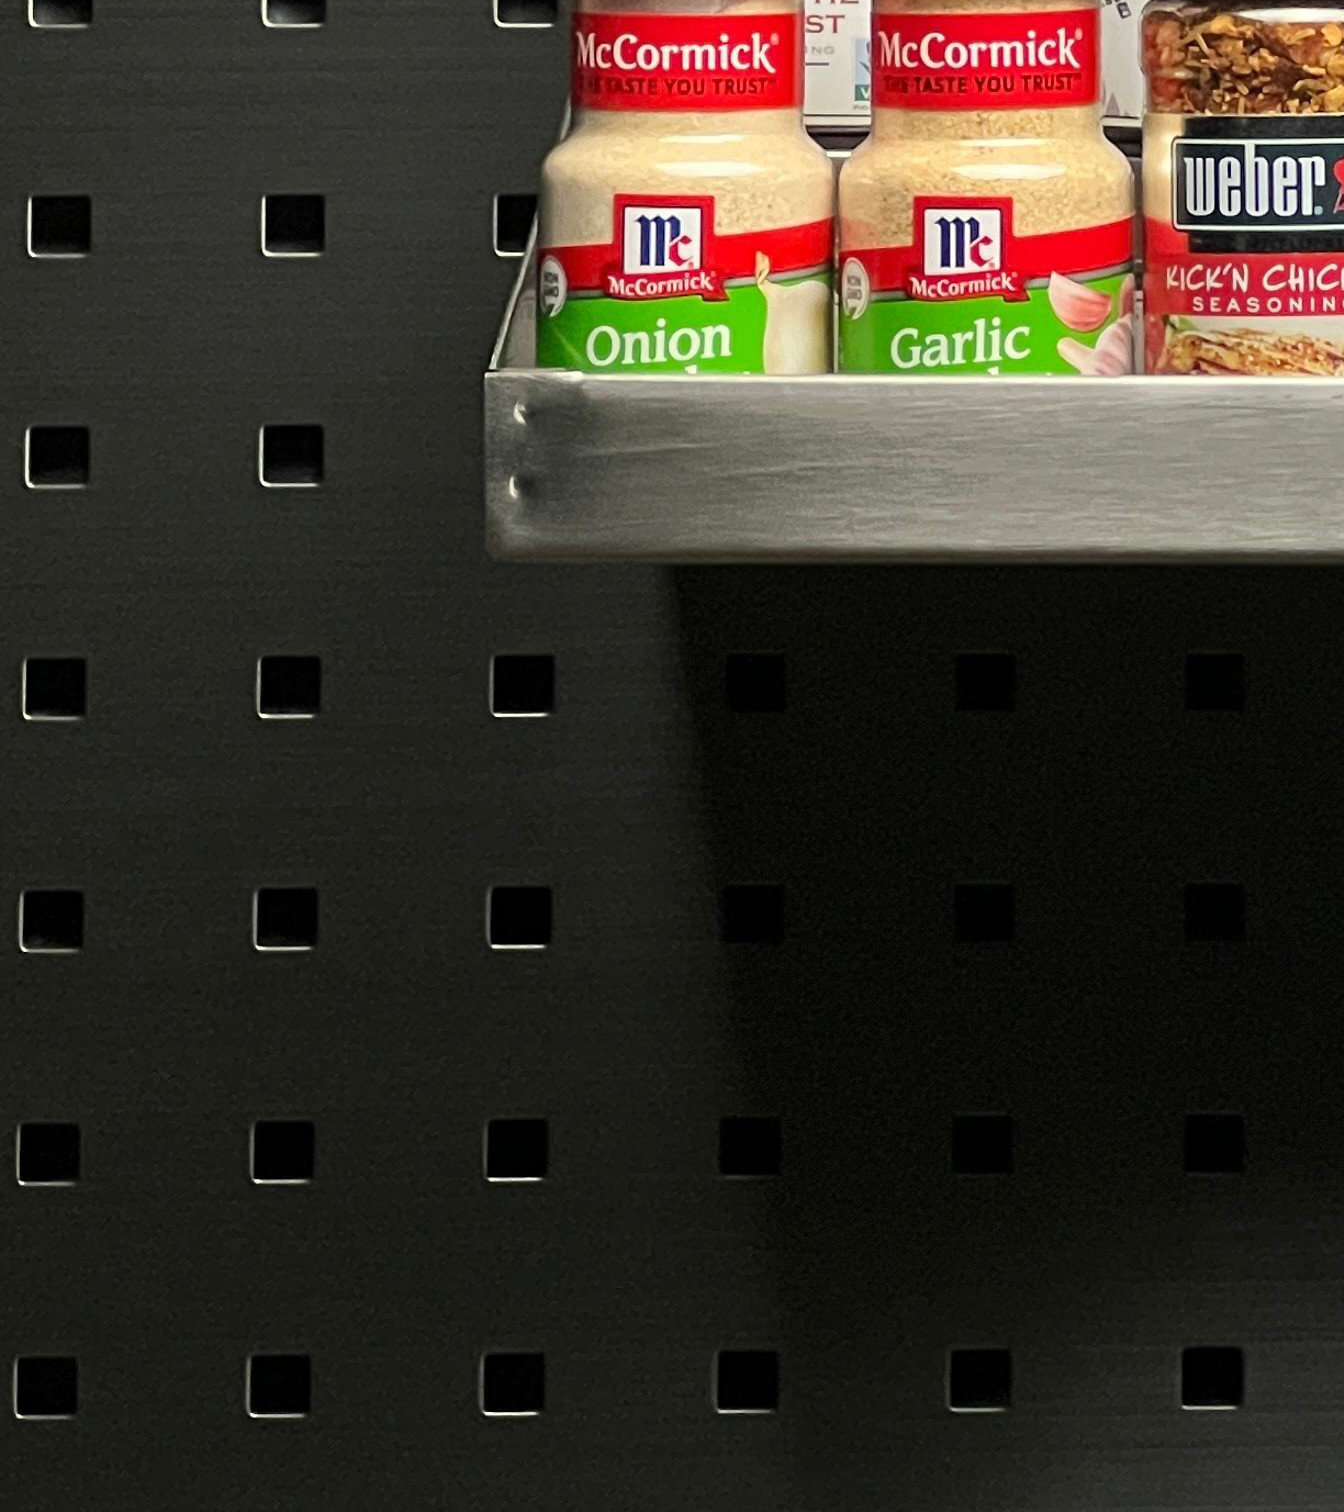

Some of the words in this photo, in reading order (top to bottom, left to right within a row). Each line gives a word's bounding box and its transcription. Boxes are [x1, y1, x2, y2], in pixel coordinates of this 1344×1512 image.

[575, 33, 777, 74] McCormick
[878, 27, 1082, 69] McCormick
[664, 78, 705, 96] YOU
[712, 76, 767, 95] TRUST
[913, 76, 967, 94] TASTE
[974, 76, 1014, 94] YOU
[1021, 74, 1073, 92] TRUST
[1184, 142, 1326, 217] weber
[607, 273, 714, 297] McCormick
[909, 273, 1015, 298] McCormick
[1165, 262, 1249, 293] KICK'N
[586, 318, 732, 367] Onion
[890, 318, 1031, 369] Garlic
